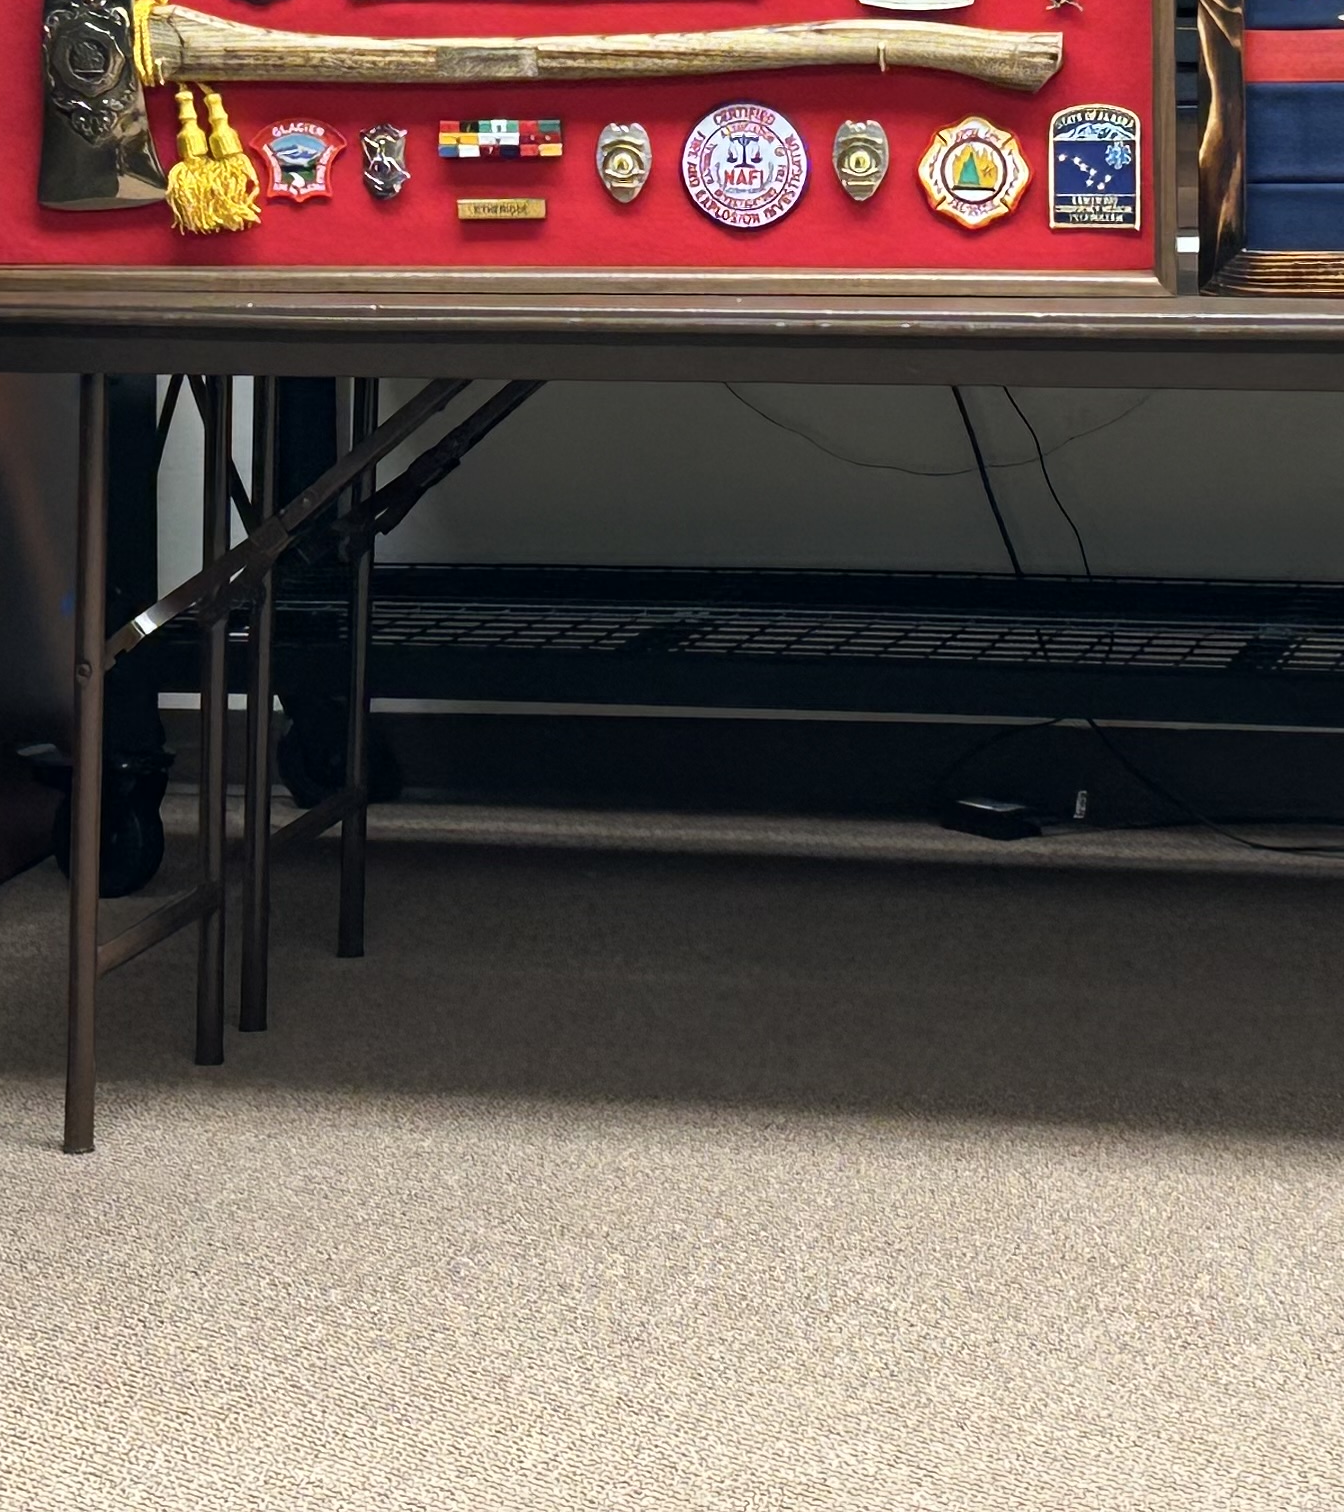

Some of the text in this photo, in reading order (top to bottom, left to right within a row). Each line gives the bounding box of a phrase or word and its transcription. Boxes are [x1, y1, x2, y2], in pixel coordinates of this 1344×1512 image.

[713, 107, 776, 125] CERTIFIED
[1057, 112, 1082, 129] STATE
[272, 123, 325, 137] GLACIER
[724, 169, 764, 187] NAFI
[695, 189, 761, 225] EXPLOSION
